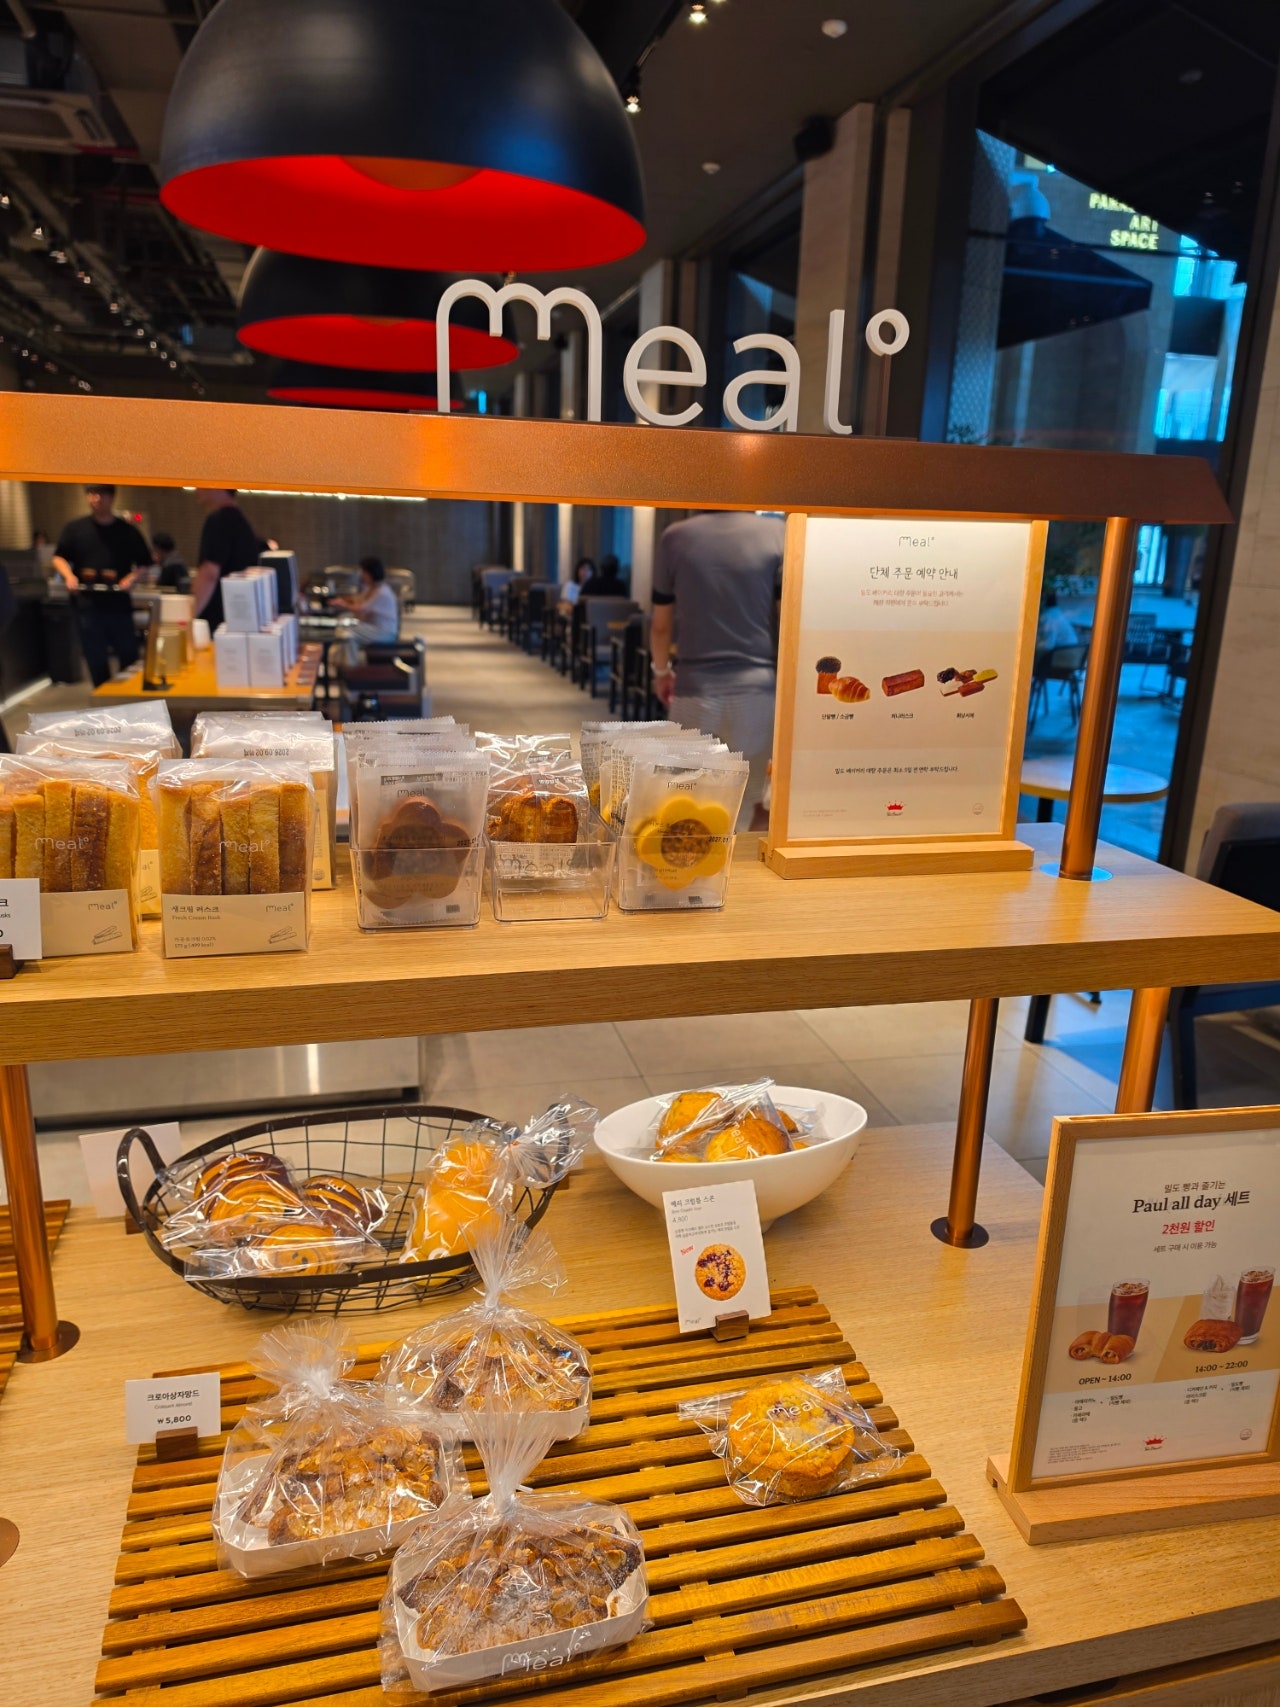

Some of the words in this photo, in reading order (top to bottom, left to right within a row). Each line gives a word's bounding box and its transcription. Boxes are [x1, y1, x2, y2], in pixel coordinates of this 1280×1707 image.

[1110, 229, 1159, 250] SPACE
[870, 566, 889, 579] 단체
[893, 567, 913, 580] 주문
[916, 567, 936, 580] 예약
[939, 567, 958, 580] 안내
[172, 905, 194, 913] 생크림
[196, 905, 219, 913] 러스크
[1165, 1184, 1180, 1193] 밀도
[1182, 1182, 1199, 1191] 빵과
[1201, 1181, 1226, 1190] 즐기는
[1132, 1198, 1168, 1213] Paul
[1171, 1196, 1190, 1210] all
[1194, 1195, 1221, 1210] day
[1224, 1191, 1250, 1206] 세트
[1162, 1221, 1191, 1235] 2천원
[1194, 1219, 1215, 1233] 할인
[681, 1244, 694, 1256] New
[1225, 1360, 1248, 1370] 22:00
[1078, 1377, 1101, 1385] OPEN
[1108, 1373, 1132, 1382] 14:00
[147, 1389, 200, 1401] 크로아상자망드
